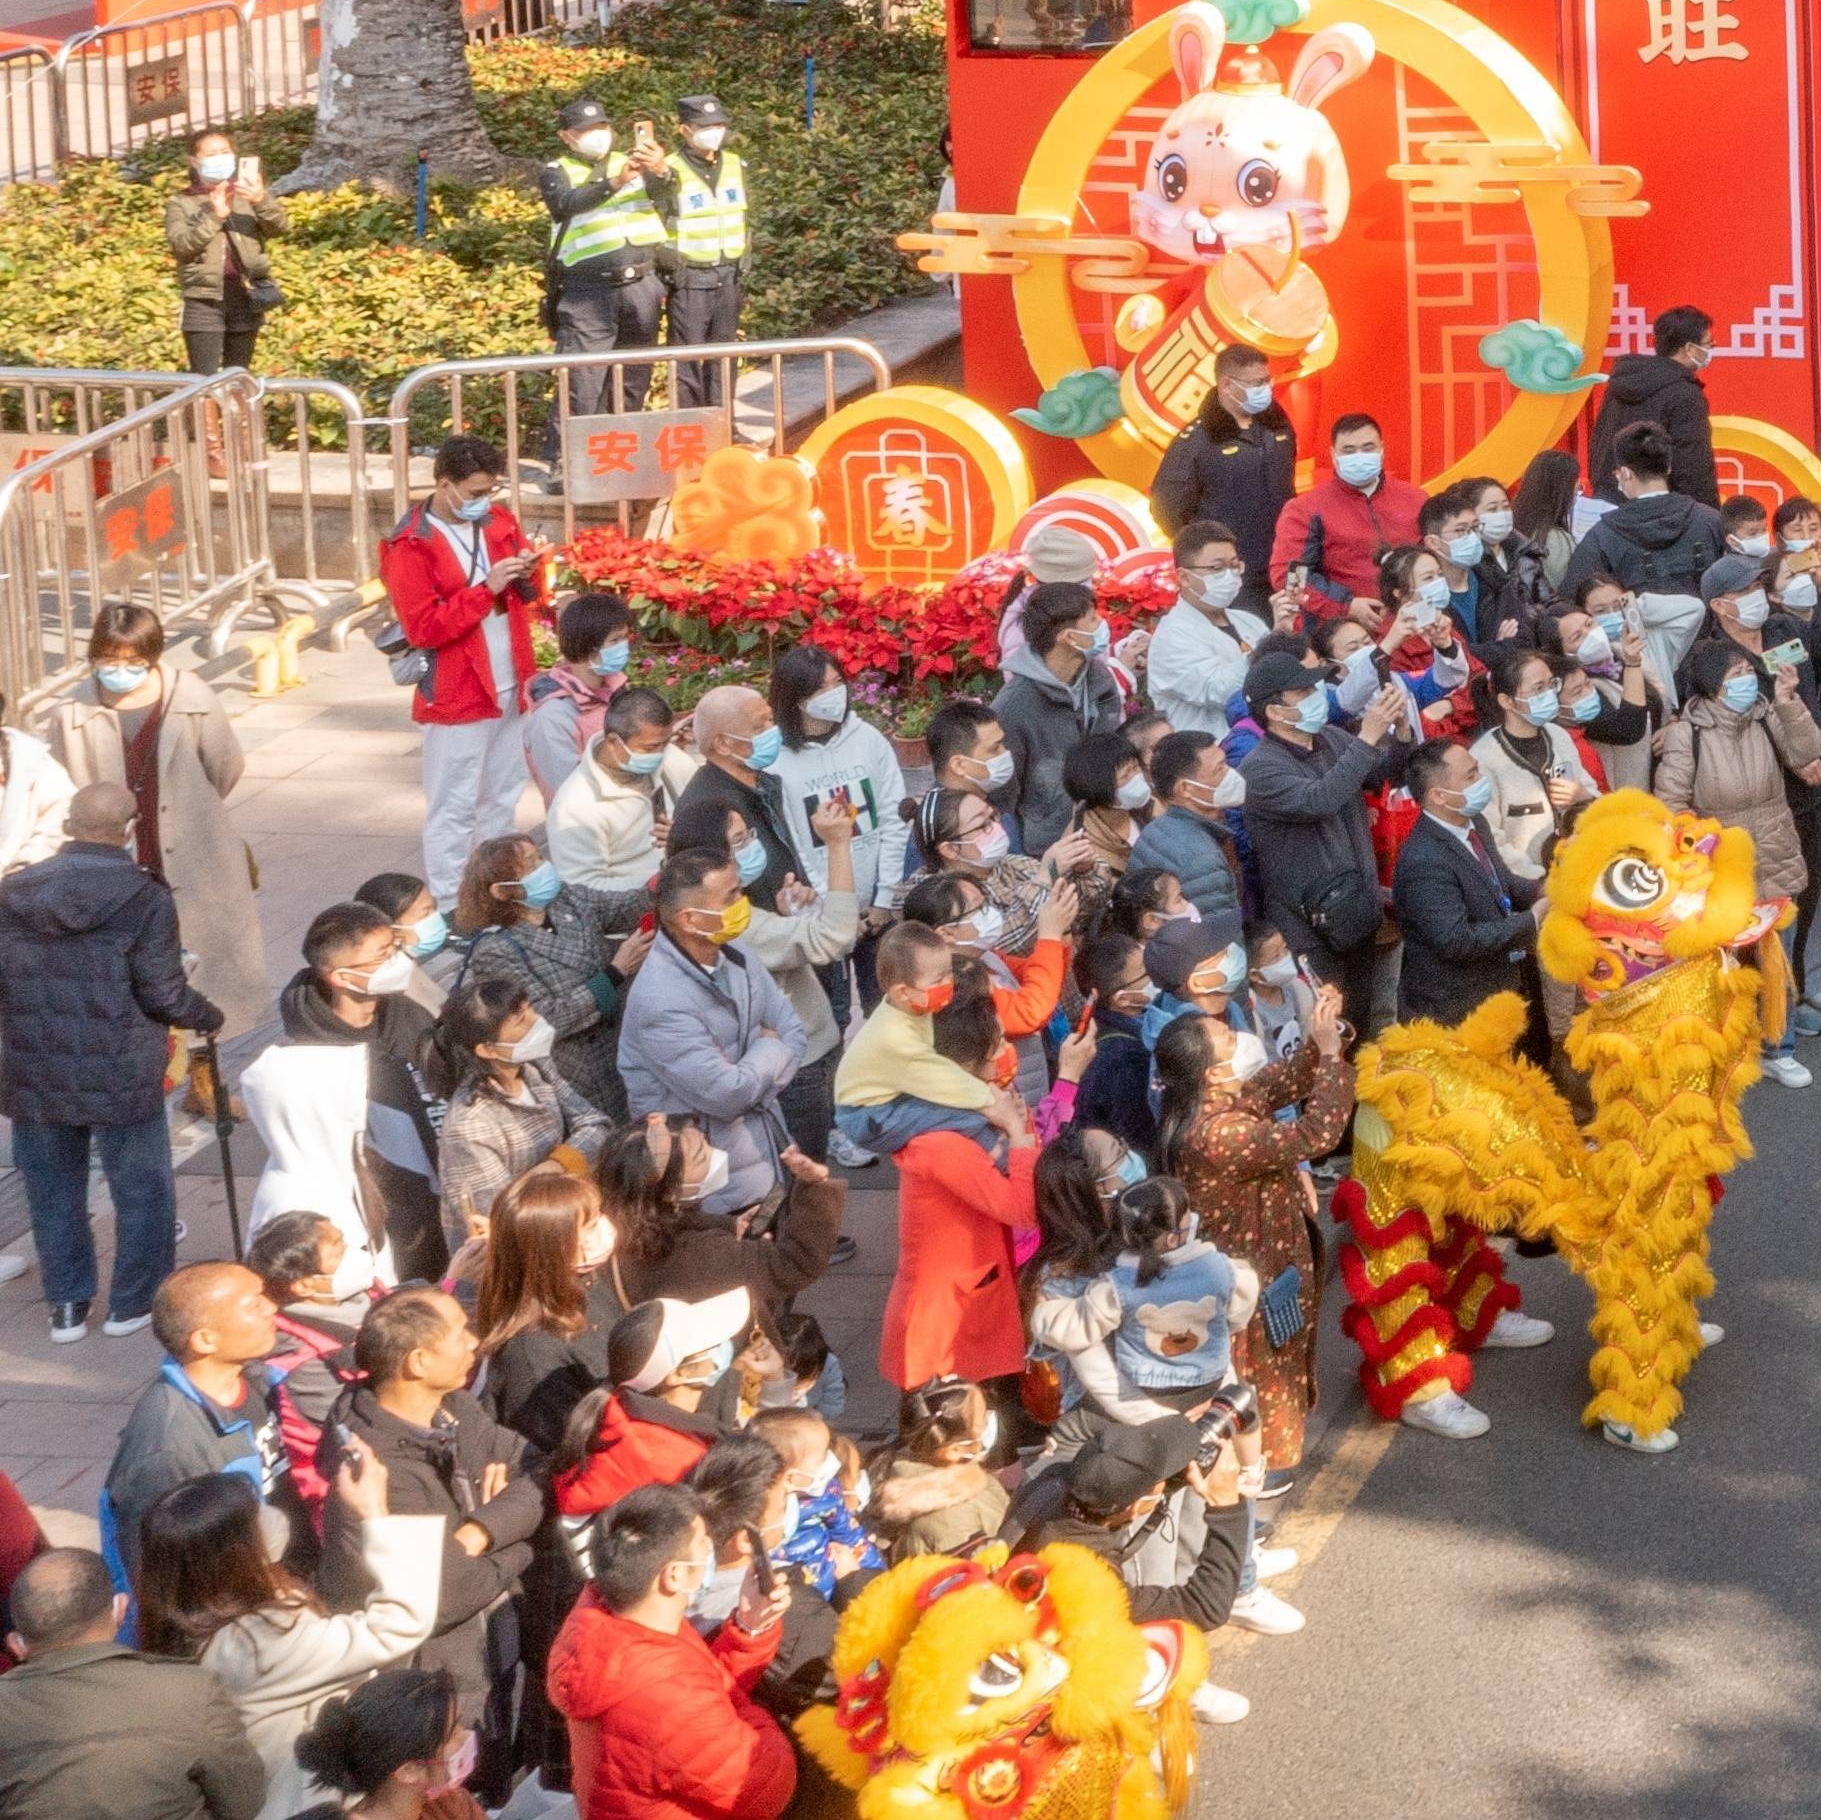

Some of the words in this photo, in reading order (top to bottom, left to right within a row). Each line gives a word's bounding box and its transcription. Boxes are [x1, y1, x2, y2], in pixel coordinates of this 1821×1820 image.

[135, 66, 181, 106] 安保
[586, 423, 707, 477] 安保
[872, 463, 956, 547] 春
